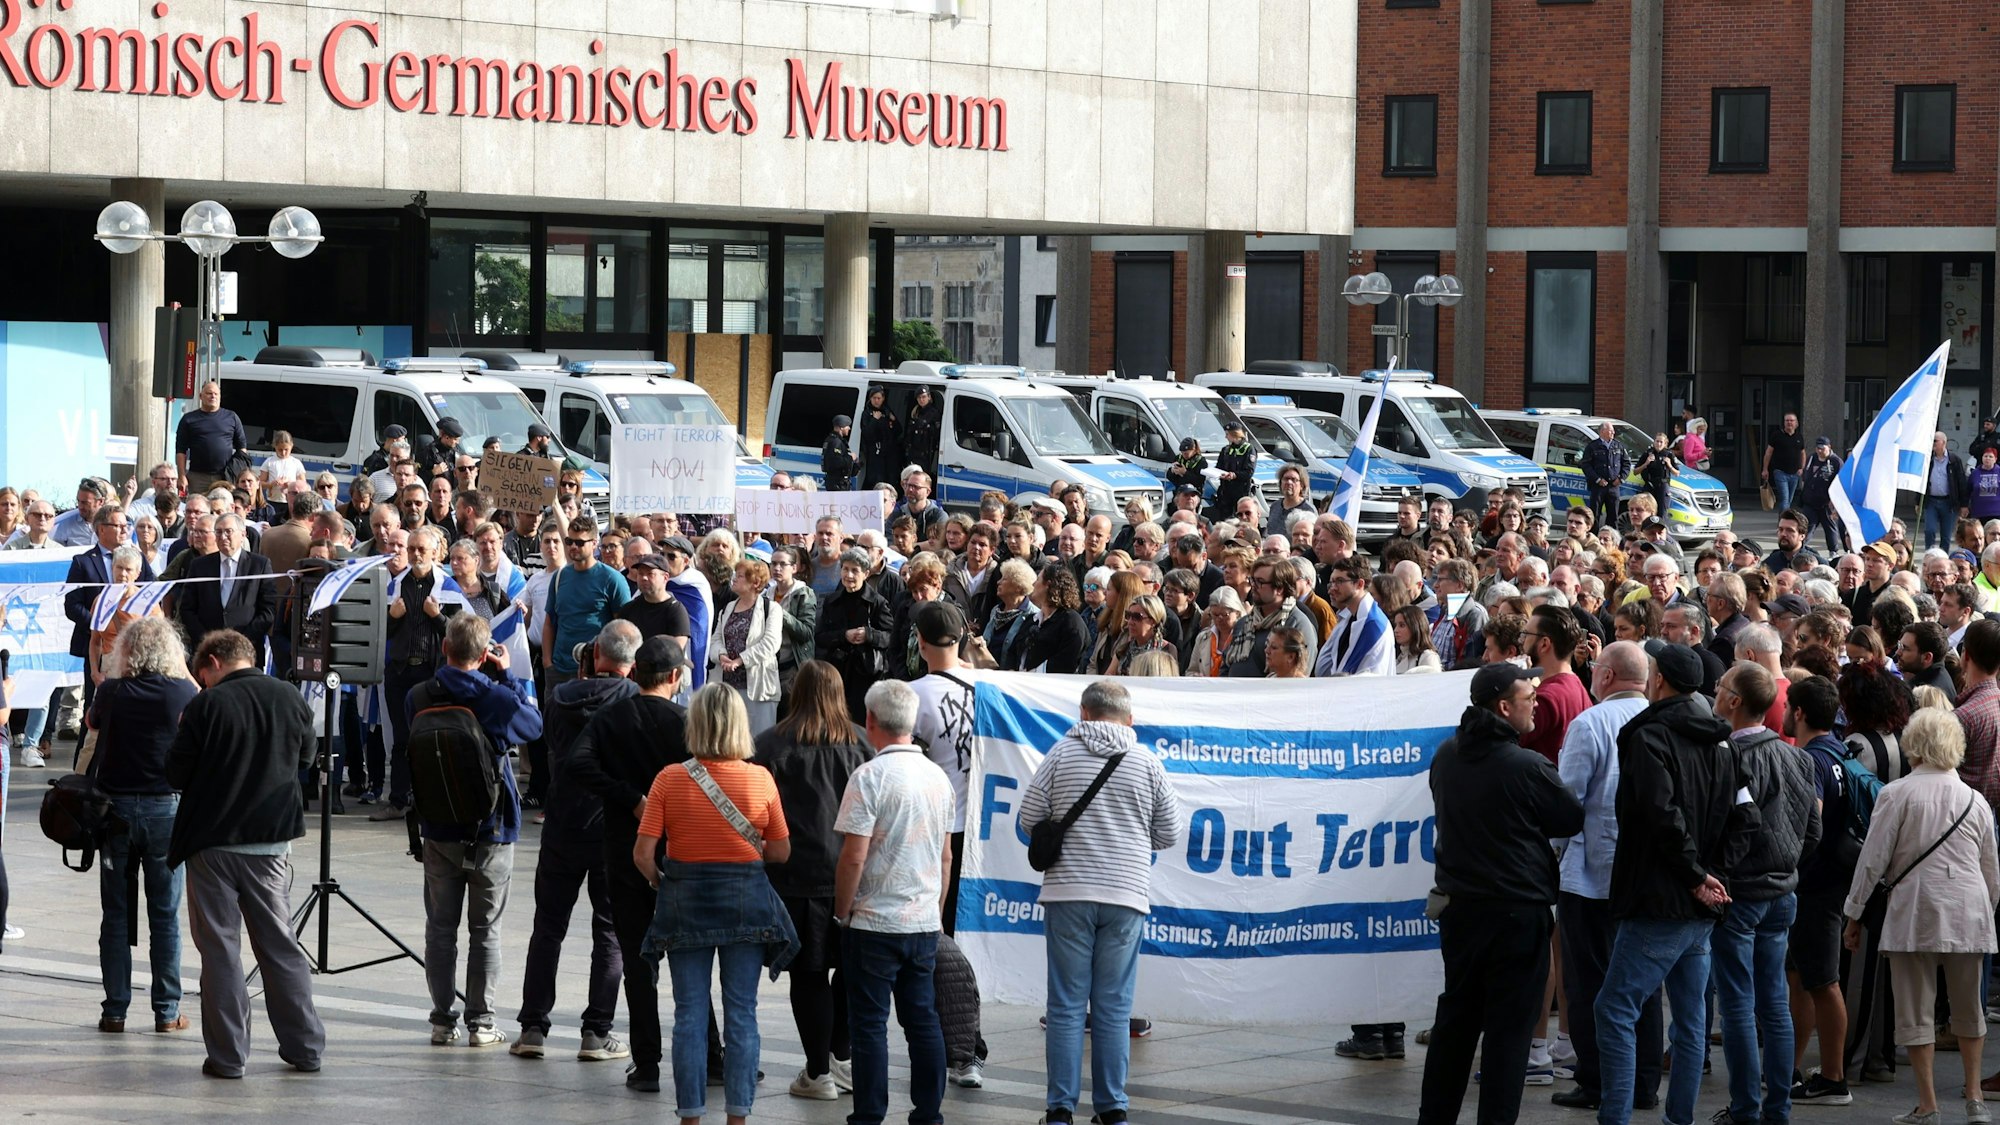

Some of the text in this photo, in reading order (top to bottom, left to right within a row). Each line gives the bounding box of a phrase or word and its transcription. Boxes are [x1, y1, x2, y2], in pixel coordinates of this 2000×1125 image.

[0, 0, 1009, 152] Römisch-Germanisches Museum
[624, 427, 725, 442] FIGHT TERROR
[486, 453, 533, 472] SIEGEN
[651, 457, 704, 482] NOW!
[500, 480, 543, 496] Stands
[1550, 477, 1588, 491] POLIZEI
[497, 498, 536, 513] ISRAEL
[615, 495, 732, 511] DE-ESCALATE LATER
[735, 500, 760, 514] STOP
[766, 502, 814, 519] FUNDING
[1155, 738, 1421, 771] Selbstverteidigung Israels
[1186, 808, 1292, 878] Out
[984, 892, 1045, 924] Gegen
